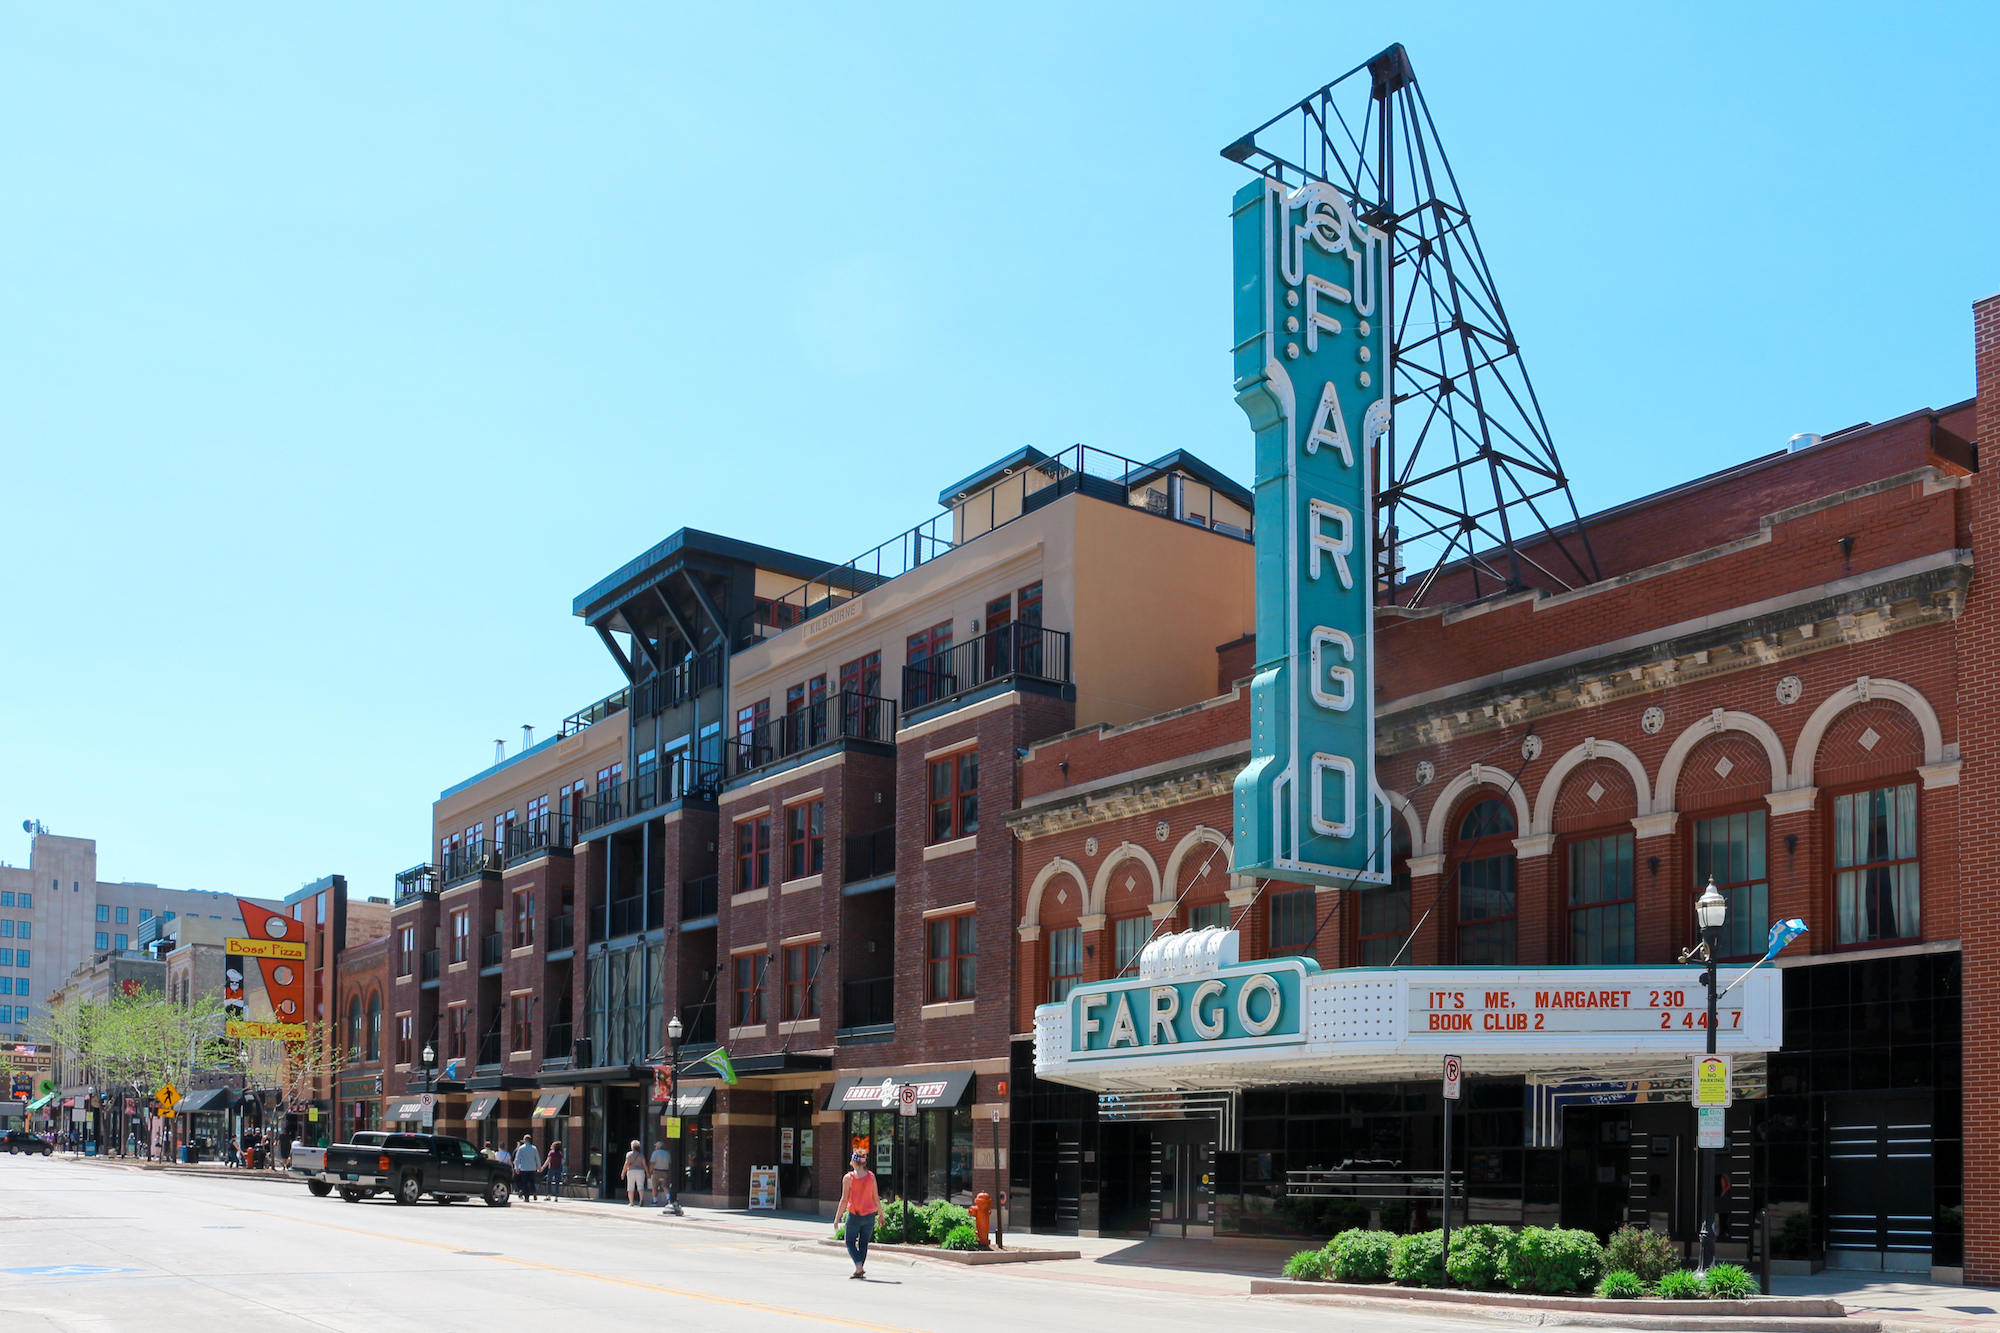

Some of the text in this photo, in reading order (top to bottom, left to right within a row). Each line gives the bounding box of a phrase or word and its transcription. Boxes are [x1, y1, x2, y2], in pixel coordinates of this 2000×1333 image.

[1306, 274, 1356, 839] FARGO
[809, 604, 856, 635] KILBOURNE
[230, 940, 302, 957] Boss' Pizza
[1429, 990, 1685, 1009] IT'S ME, MARGARET 230
[1079, 973, 1282, 1051] FARGO
[1429, 1013, 1473, 1031] BOOK
[1484, 1013, 1528, 1031] CLUB
[1534, 1013, 1545, 1030] 2
[1731, 1011, 1741, 1028] 7
[846, 1088, 881, 1098] ERBERT
[893, 1084, 943, 1097] GERT'S
[982, 1153, 1001, 1165] 200
